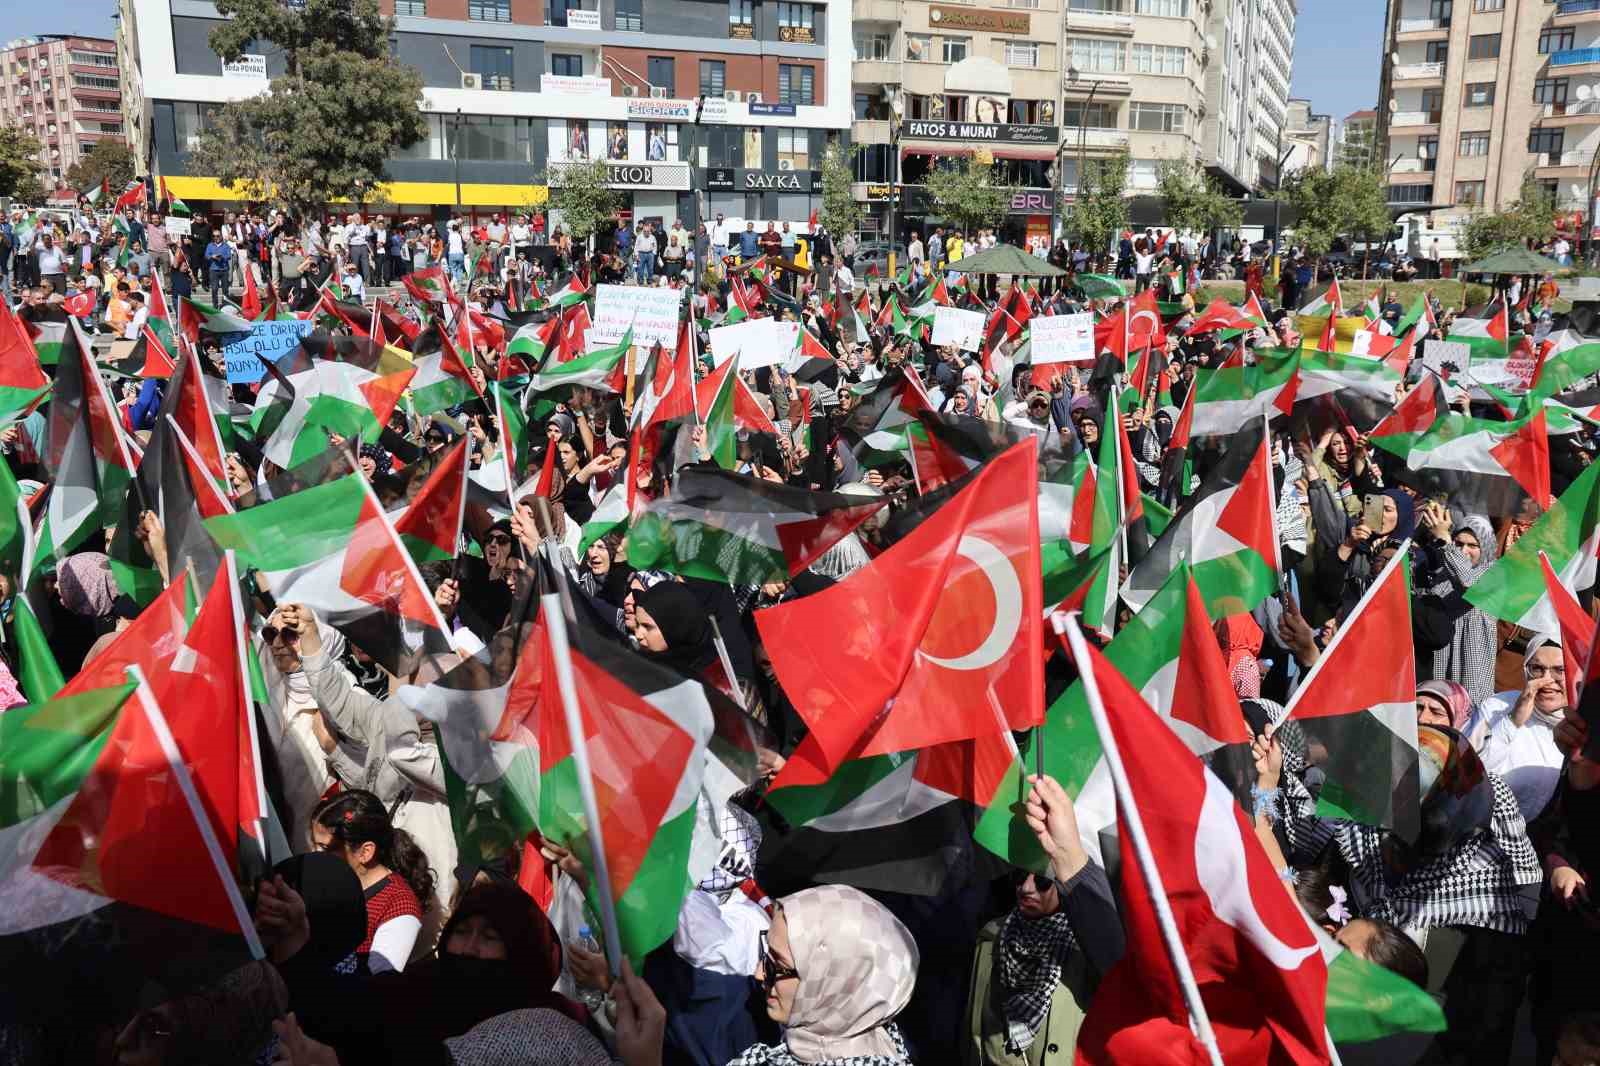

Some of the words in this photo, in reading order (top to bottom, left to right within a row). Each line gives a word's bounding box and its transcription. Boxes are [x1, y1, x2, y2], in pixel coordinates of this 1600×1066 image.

[949, 124, 957, 136] &
[960, 125, 999, 138] MURAT
[745, 172, 801, 188] SAYKA
[869, 185, 900, 196] Meydn
